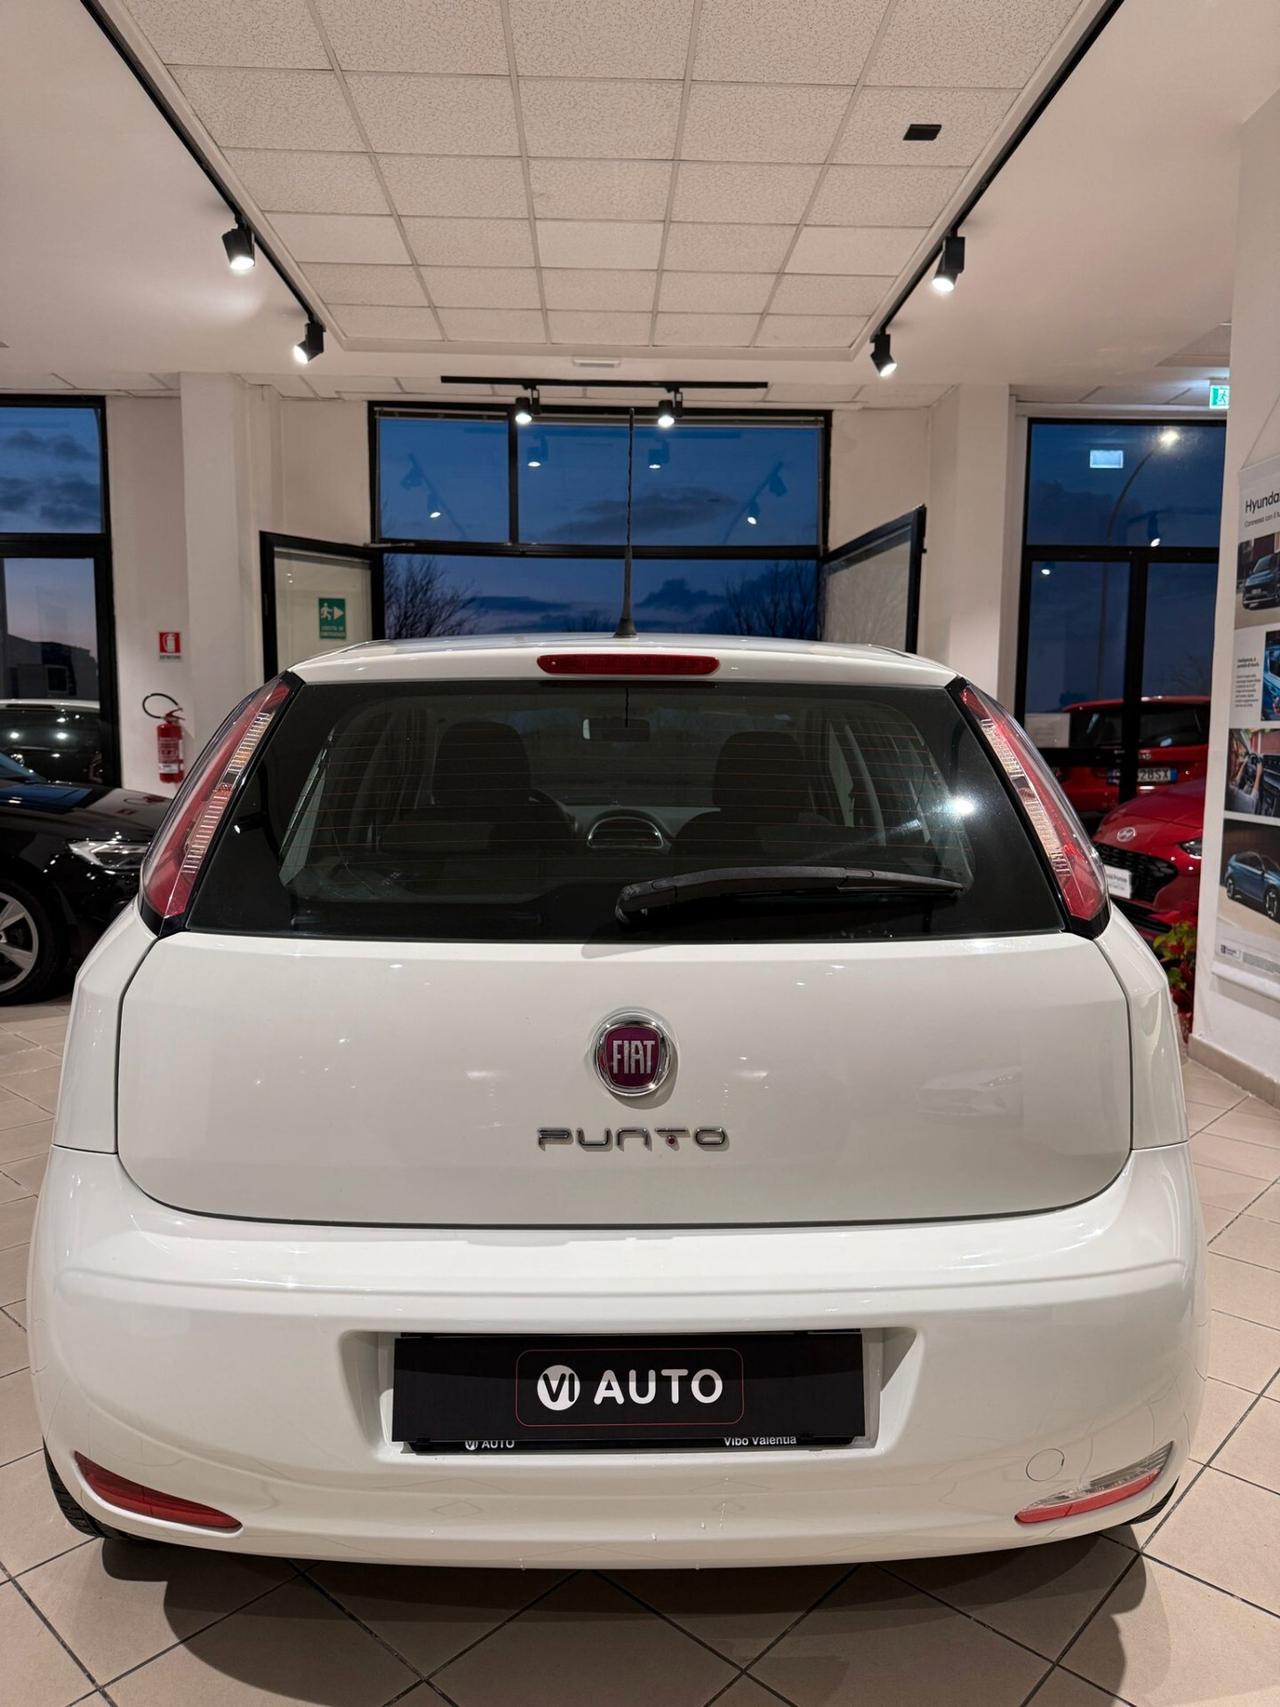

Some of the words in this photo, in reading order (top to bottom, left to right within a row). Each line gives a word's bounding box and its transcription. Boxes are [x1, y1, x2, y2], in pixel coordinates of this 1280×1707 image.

[1245, 491, 1280, 514] Hyunda
[612, 1040, 656, 1074] FIAT
[537, 1127, 728, 1149] PUNTO
[537, 1365, 580, 1410] VI
[593, 1368, 724, 1405] AUTO
[481, 1440, 515, 1449] AUTO
[724, 1437, 749, 1447] Vibo
[752, 1436, 797, 1446] Valentia
